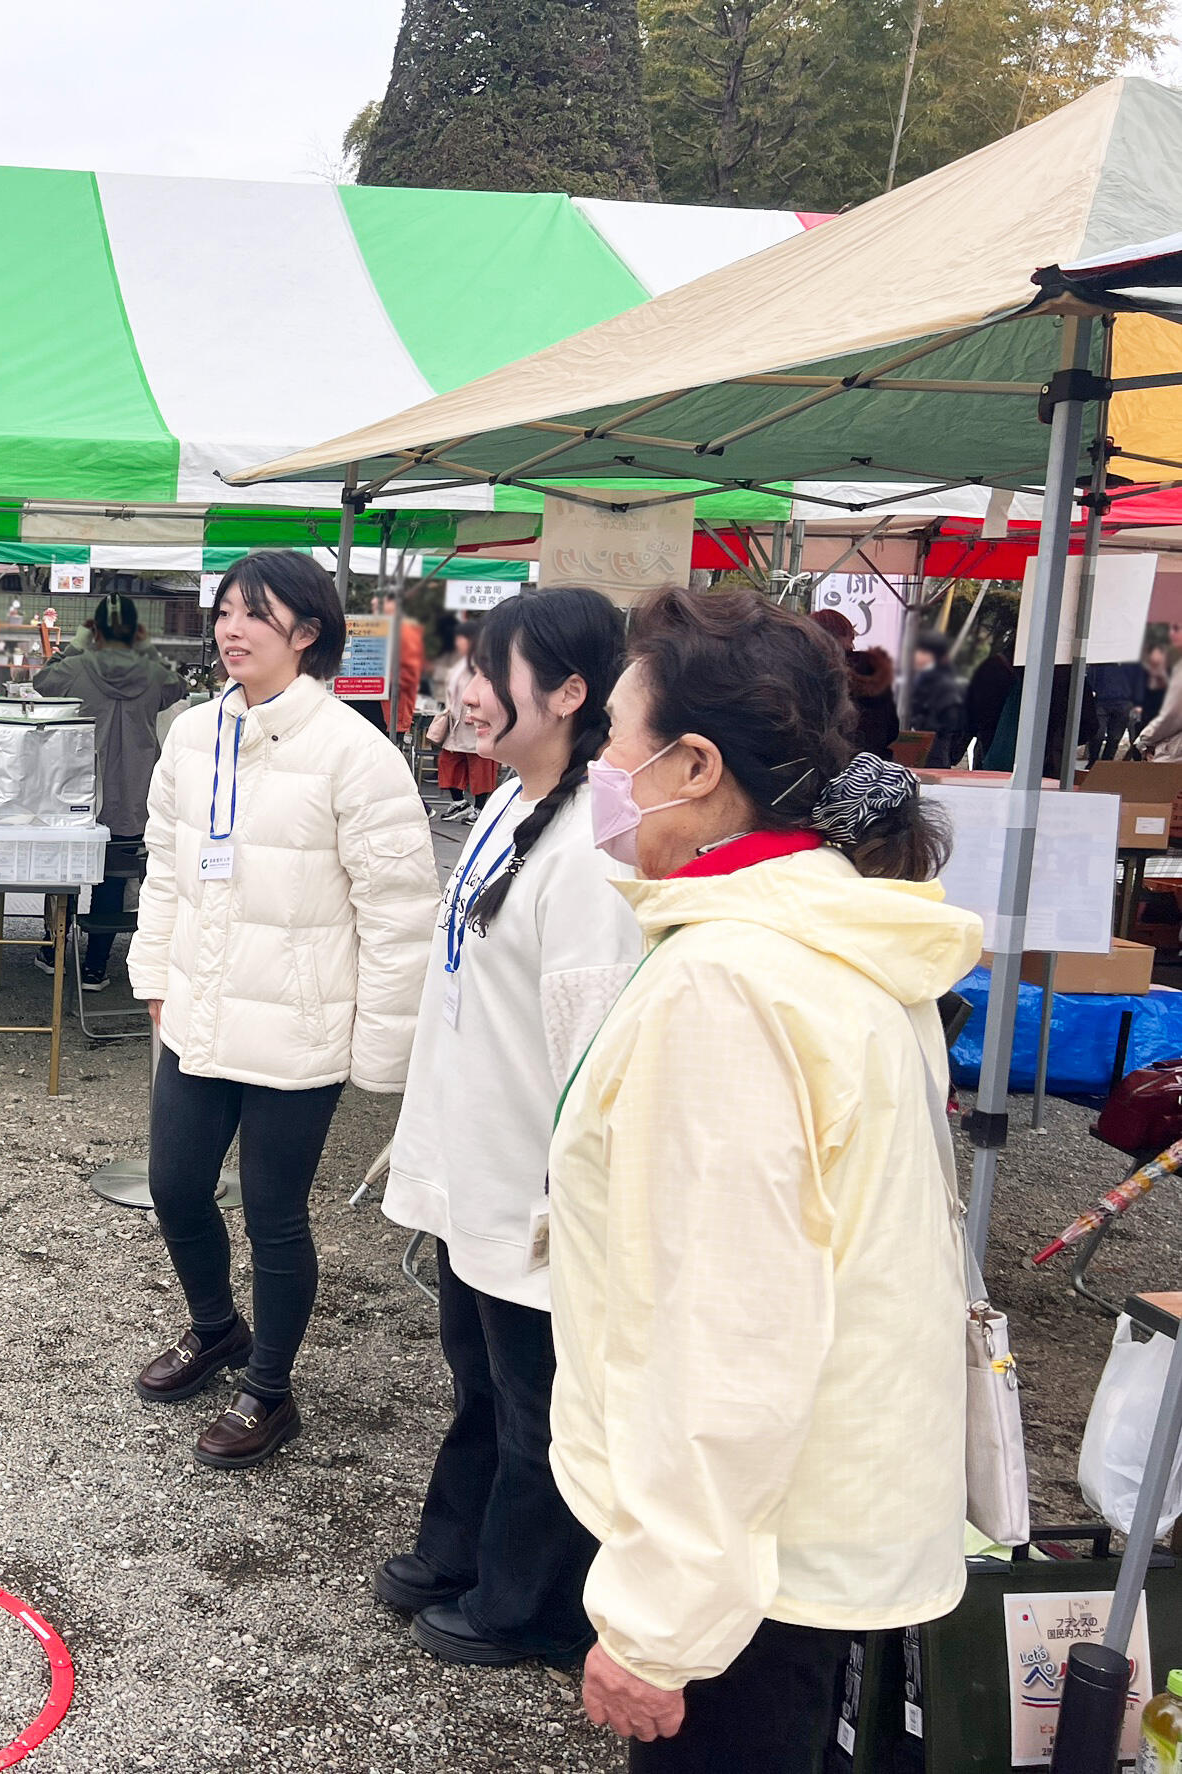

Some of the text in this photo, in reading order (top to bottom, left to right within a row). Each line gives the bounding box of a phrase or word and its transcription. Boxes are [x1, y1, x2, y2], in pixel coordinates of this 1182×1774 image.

[1055, 1616, 1098, 1628] フランスの
